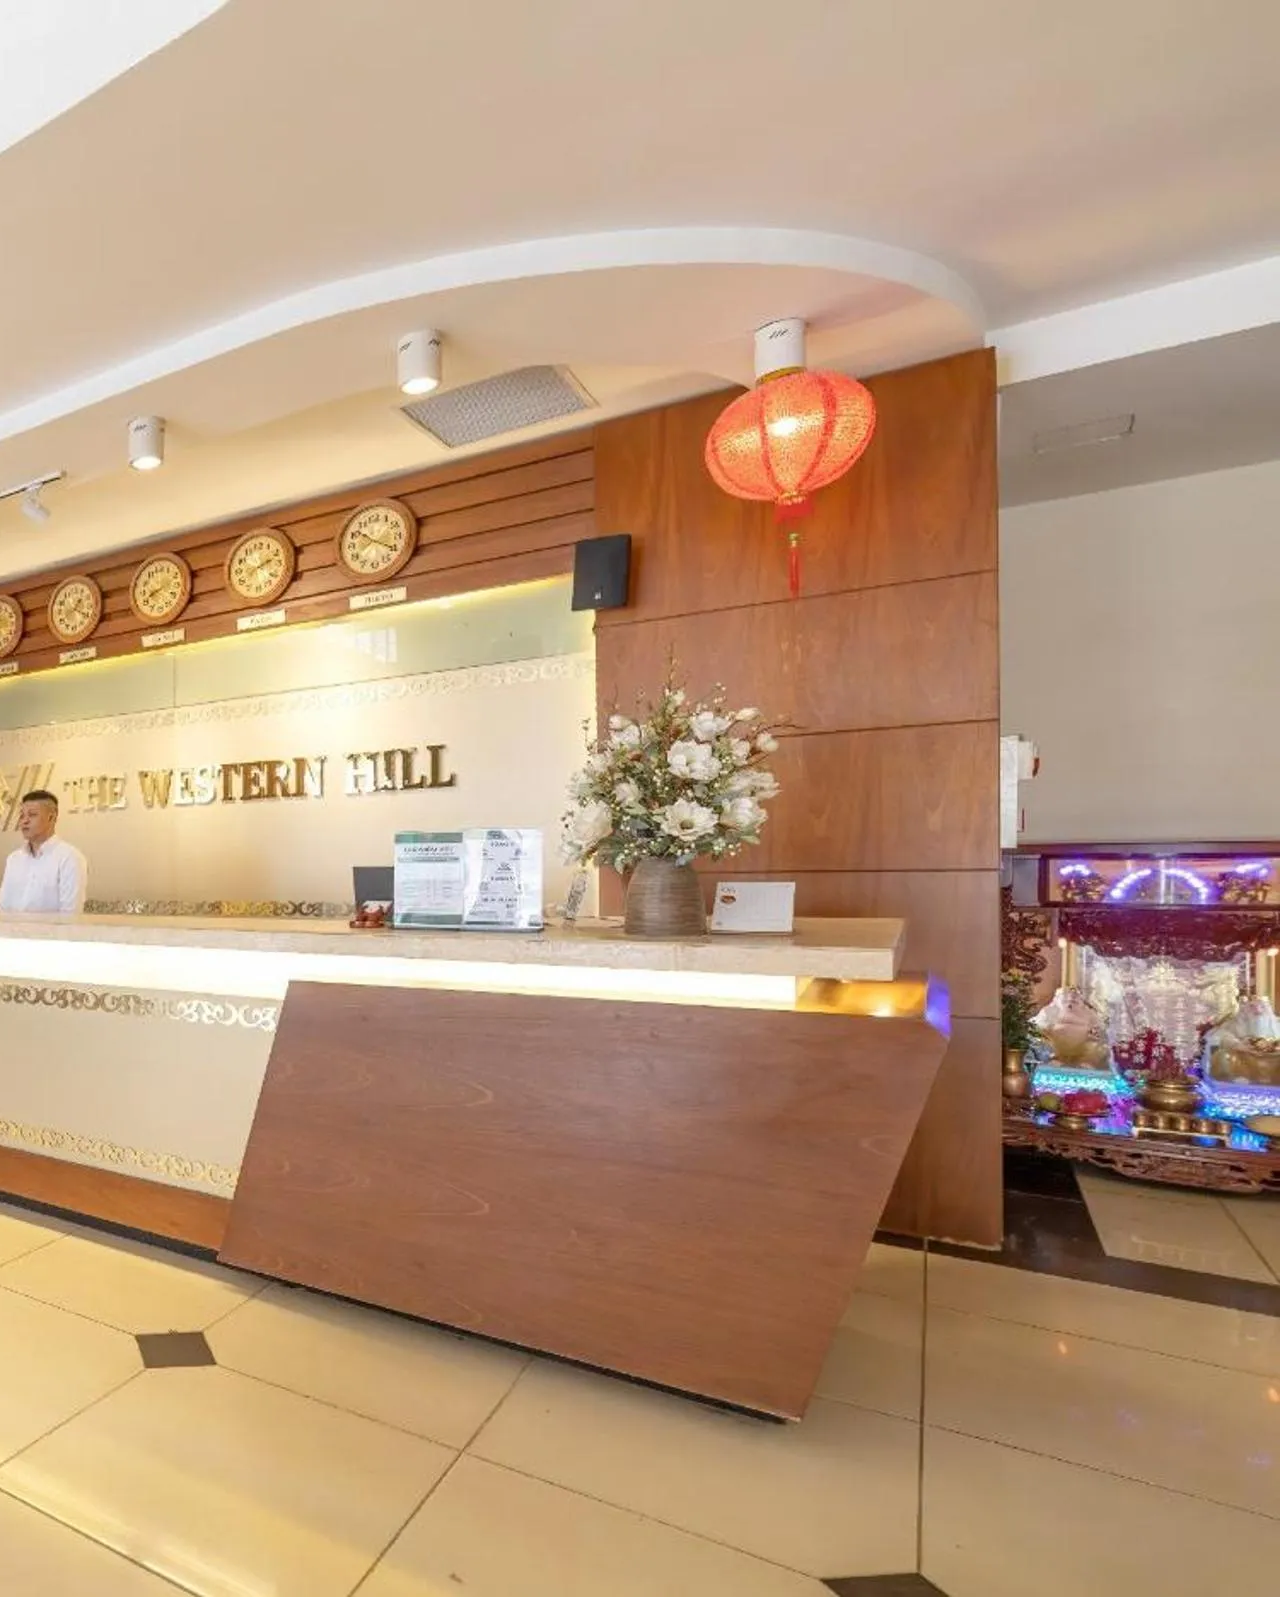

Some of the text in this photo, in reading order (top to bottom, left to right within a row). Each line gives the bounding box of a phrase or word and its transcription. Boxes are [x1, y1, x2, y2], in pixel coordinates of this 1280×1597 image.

[64, 744, 458, 814] THE WESTERN HILL
